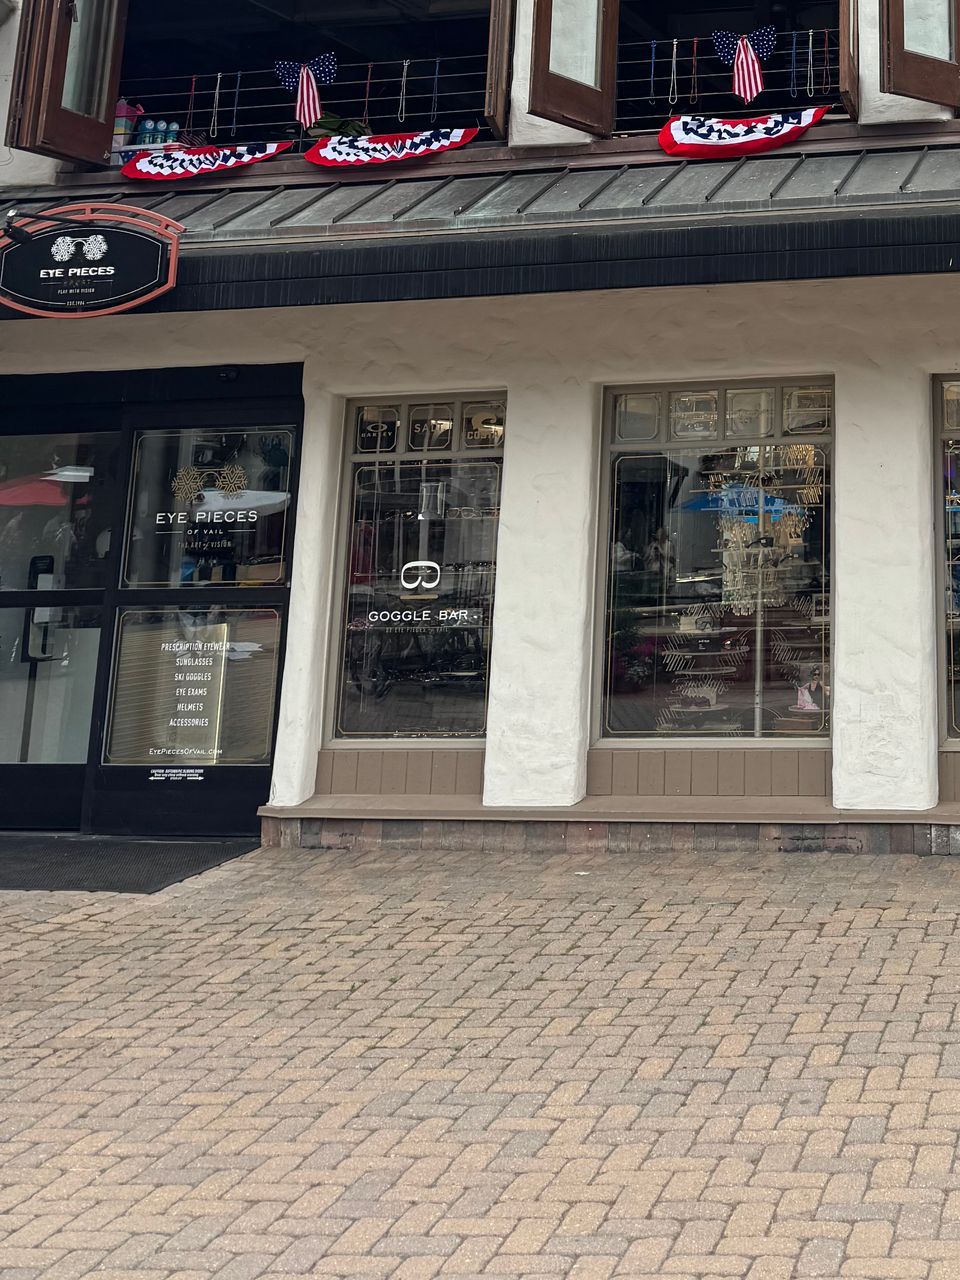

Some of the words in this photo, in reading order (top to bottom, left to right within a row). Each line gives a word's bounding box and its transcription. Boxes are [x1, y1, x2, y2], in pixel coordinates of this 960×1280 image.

[40, 268, 64, 278] EYE
[68, 267, 115, 276] PIECES
[156, 513, 187, 524] EYE
[196, 511, 258, 523] PIECES
[368, 610, 432, 621] GOGGLE
[439, 609, 468, 621] BAR
[161, 642, 203, 651] PRESCRIPTION
[203, 641, 230, 651] EYEWEAR
[176, 658, 213, 666] SUNGLASSES
[174, 673, 185, 681] SKI
[186, 673, 212, 681] GOGGLES
[176, 688, 186, 696] EYE
[187, 688, 207, 696] EXAMS
[177, 703, 203, 711] HELMETS
[169, 718, 209, 726] ACCESSORIES
